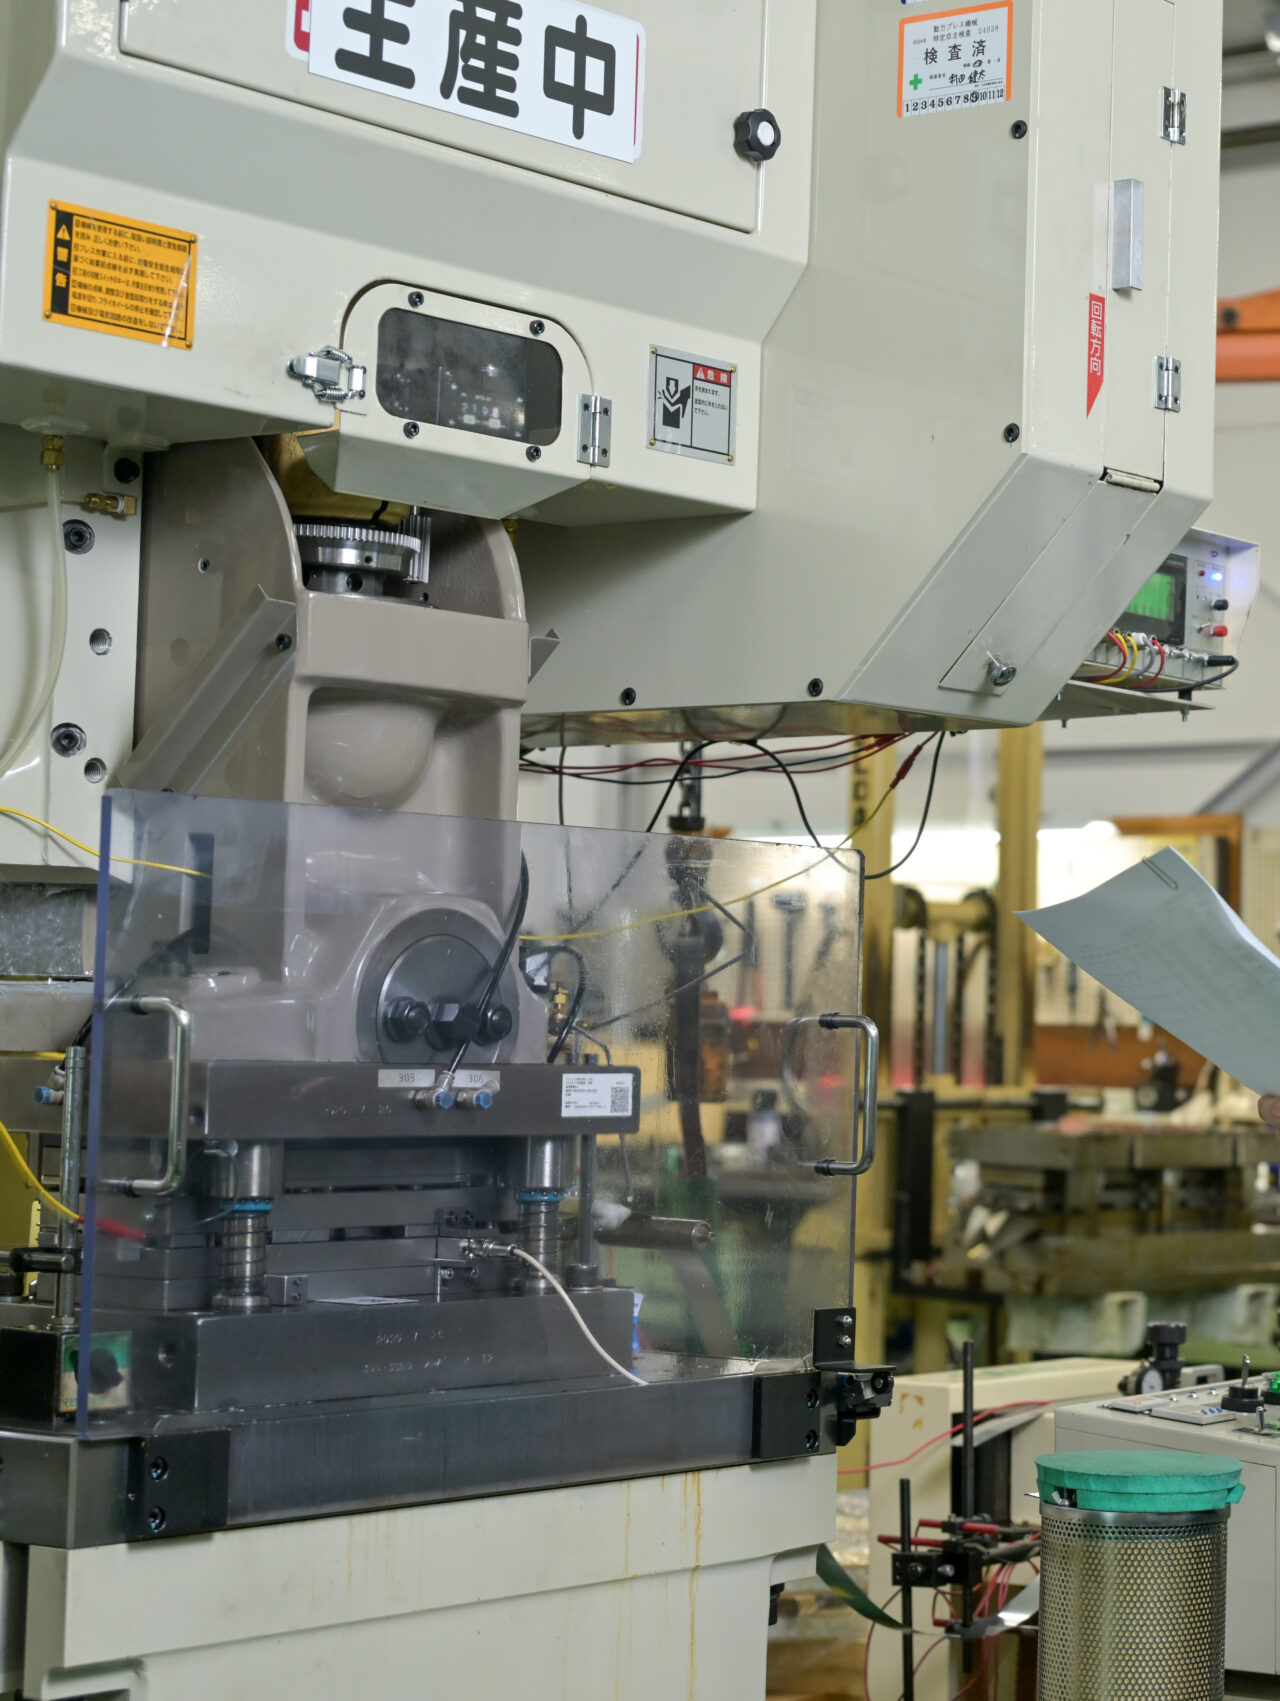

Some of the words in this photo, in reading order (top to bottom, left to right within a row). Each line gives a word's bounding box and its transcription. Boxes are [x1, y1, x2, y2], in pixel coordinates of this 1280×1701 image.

[924, 39, 986, 65] 検査済
[1090, 301, 1102, 375] 回転方向
